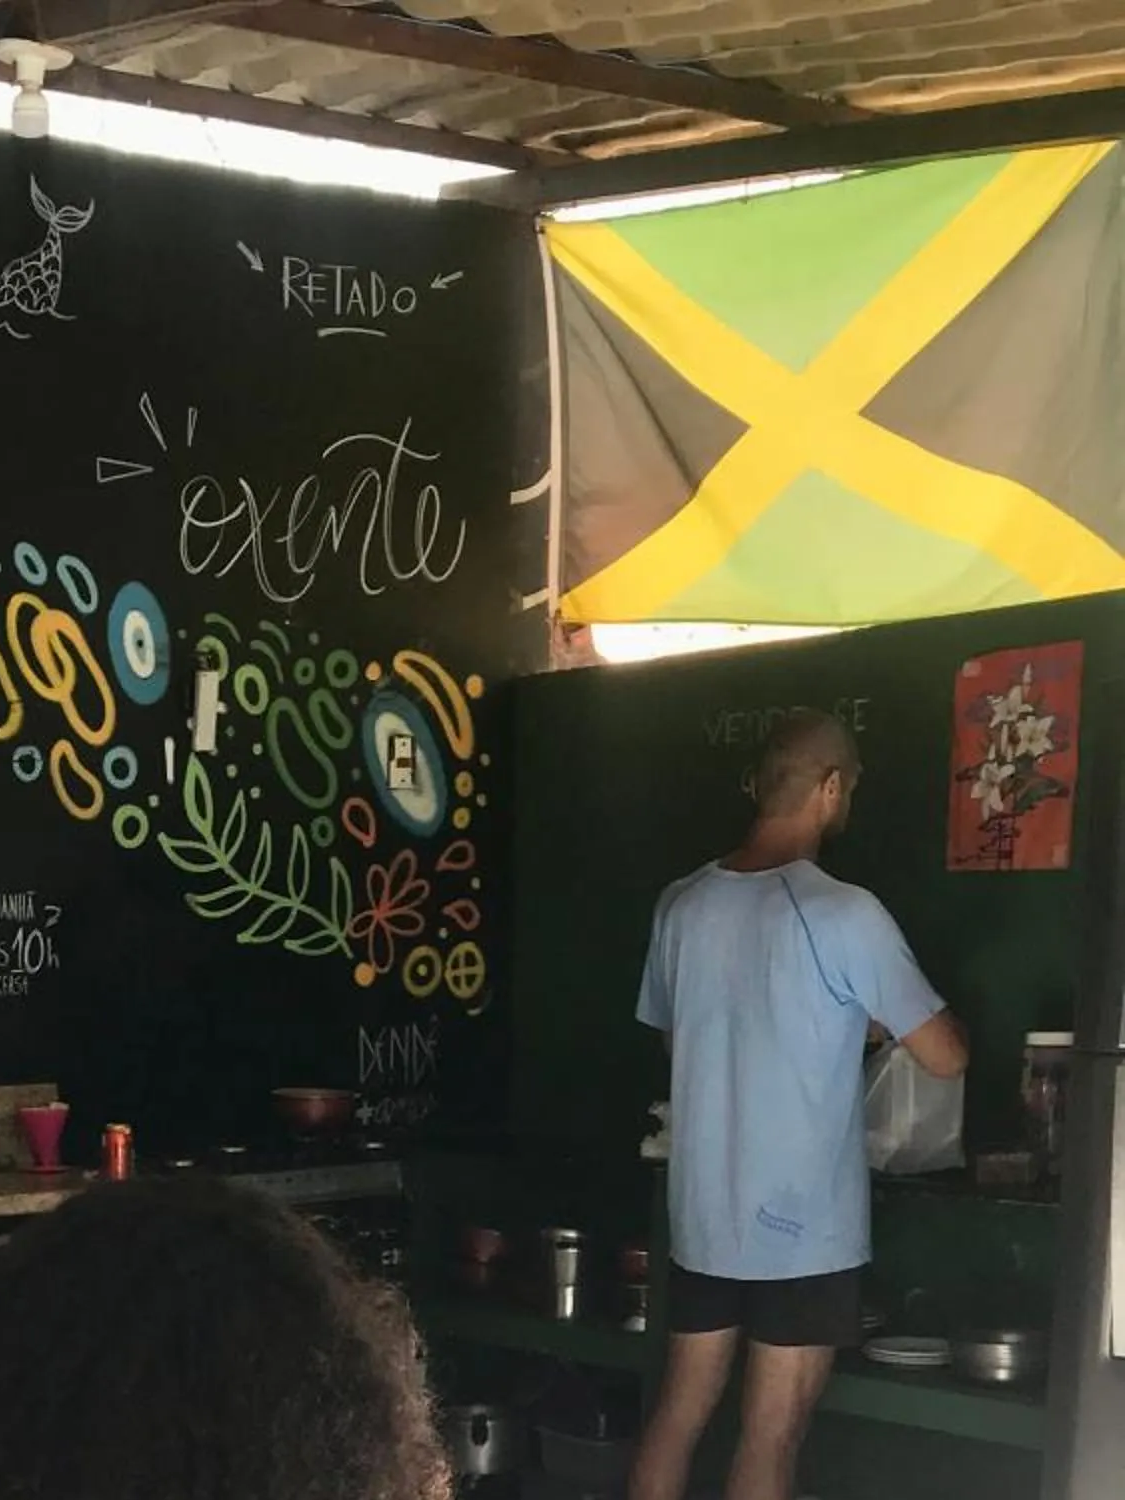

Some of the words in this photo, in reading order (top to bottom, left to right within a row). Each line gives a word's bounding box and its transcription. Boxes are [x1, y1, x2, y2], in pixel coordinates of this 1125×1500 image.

[282, 255, 417, 319] RETADO
[179, 417, 466, 602] oxente
[11, 926, 61, 974] 10h
